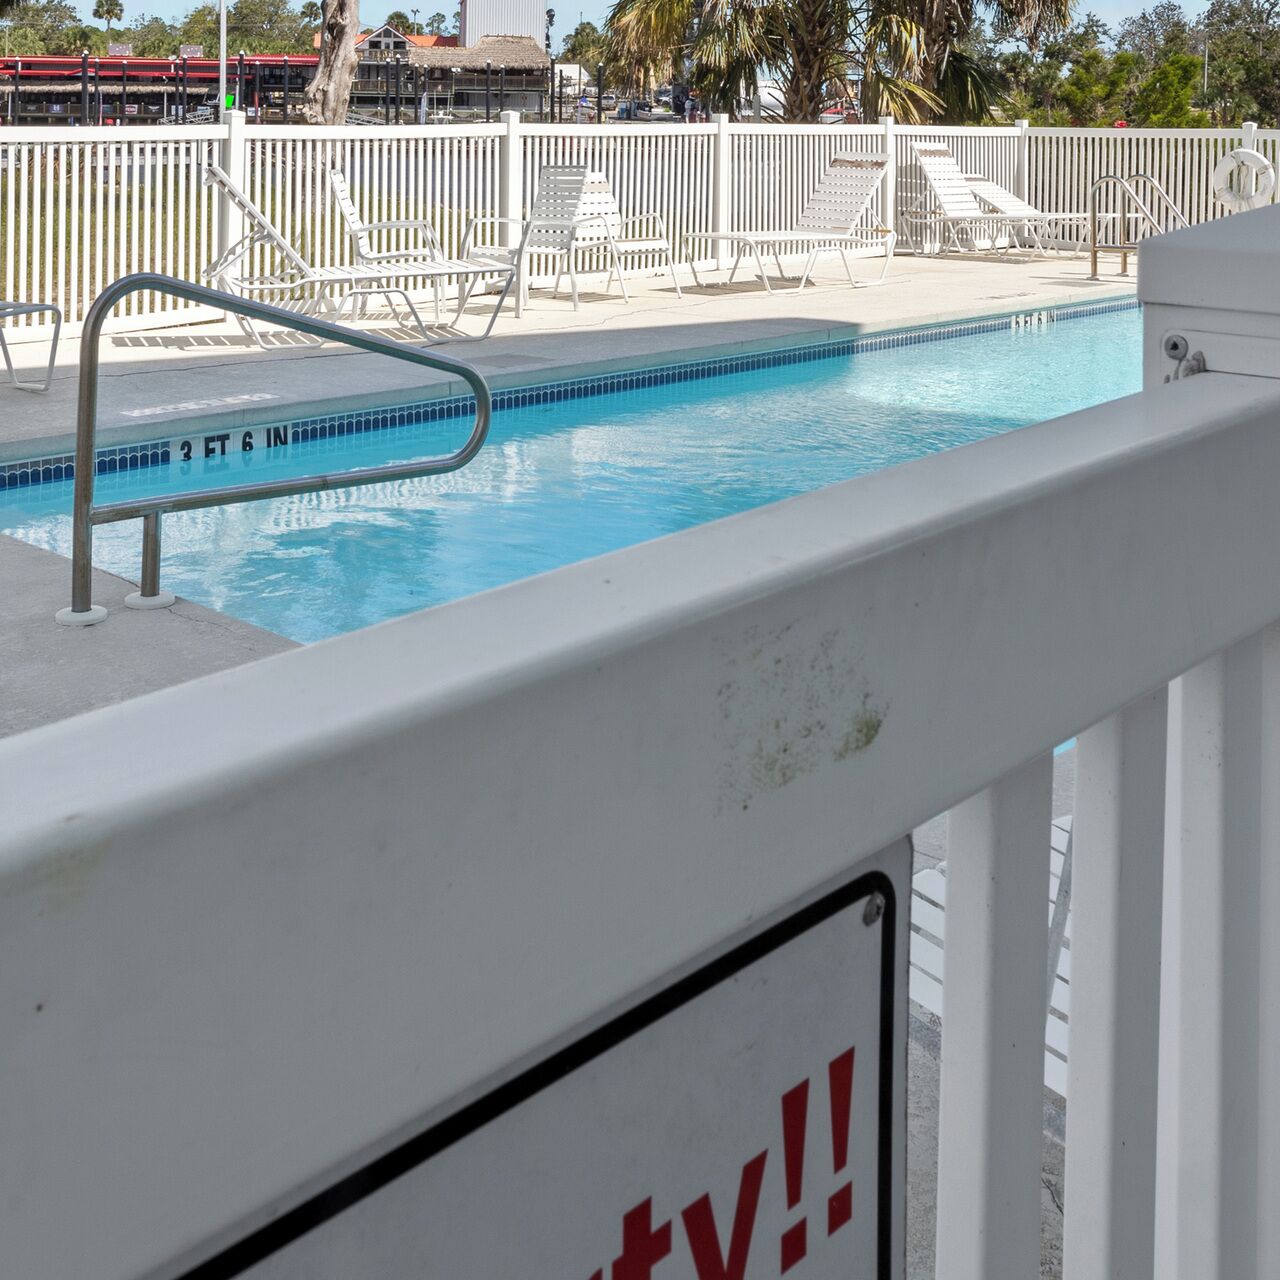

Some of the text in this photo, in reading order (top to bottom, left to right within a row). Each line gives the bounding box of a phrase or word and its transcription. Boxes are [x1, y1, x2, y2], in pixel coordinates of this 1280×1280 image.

[1024, 314, 1033, 326] FT
[1047, 308, 1055, 323] IN
[180, 425, 287, 461] 3 FT 6 IN
[587, 1045, 855, 1280] ty!!
